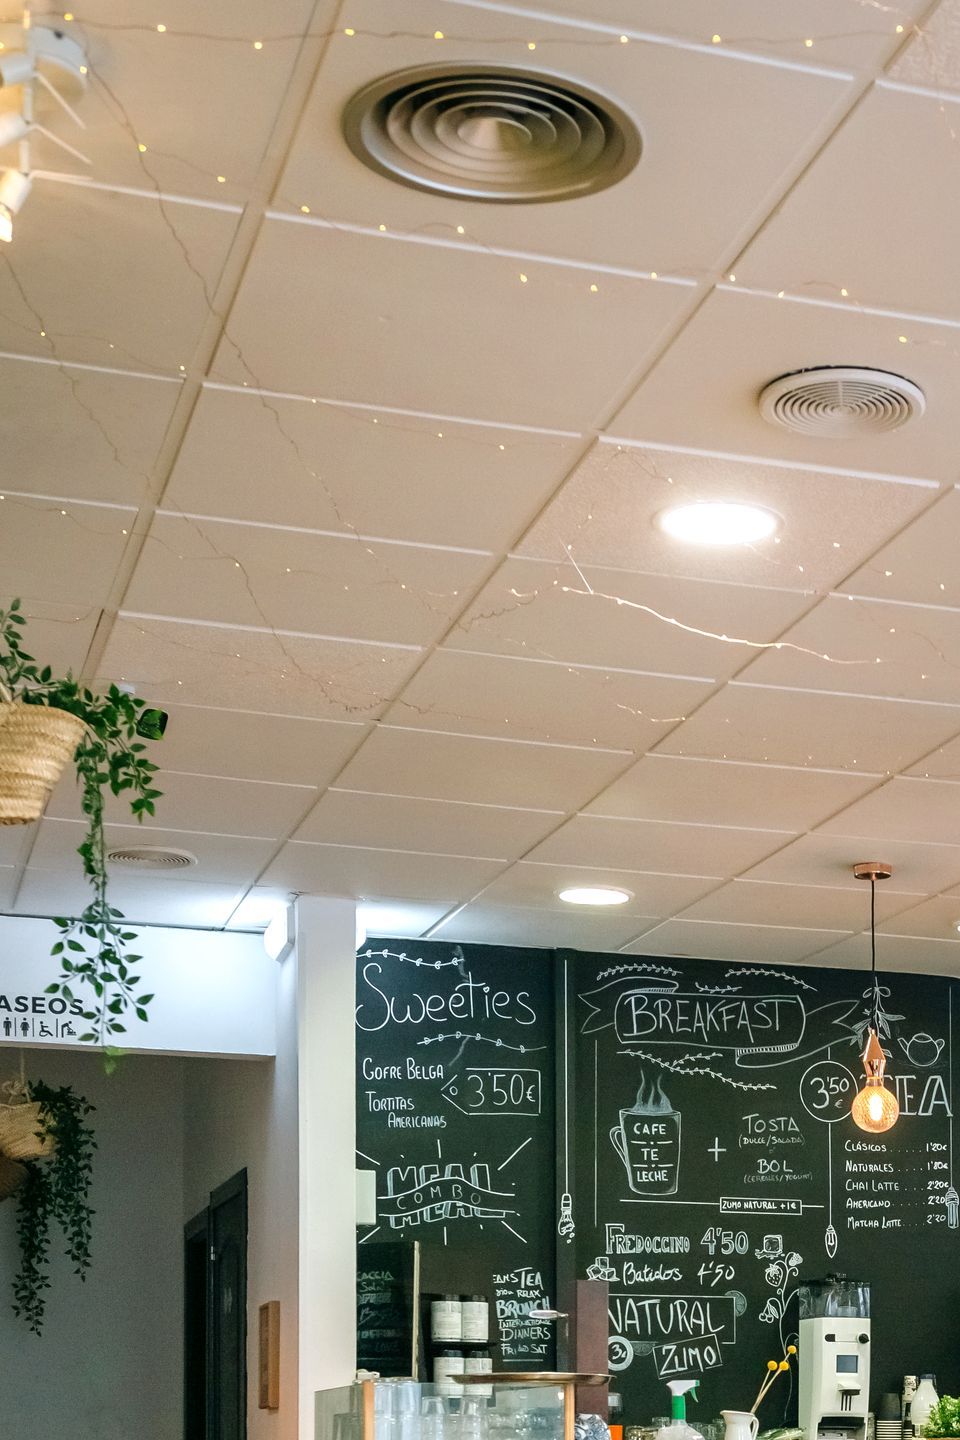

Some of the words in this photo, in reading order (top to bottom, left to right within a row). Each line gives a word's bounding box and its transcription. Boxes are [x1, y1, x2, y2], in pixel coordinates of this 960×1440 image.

[0, 995, 84, 1016] ASEOS
[355, 962, 537, 1032] Sweeties
[622, 994, 797, 1043] BREAKFAST
[632, 1123, 666, 1135] CAFE
[641, 1148, 659, 1161] TE
[637, 1170, 668, 1182] LECHE
[757, 1158, 793, 1174] BOL
[513, 1266, 545, 1290] TEA
[623, 1261, 683, 1286] Batidos
[500, 1327, 551, 1342] DINNERS
[659, 1345, 717, 1374] ZUMO
